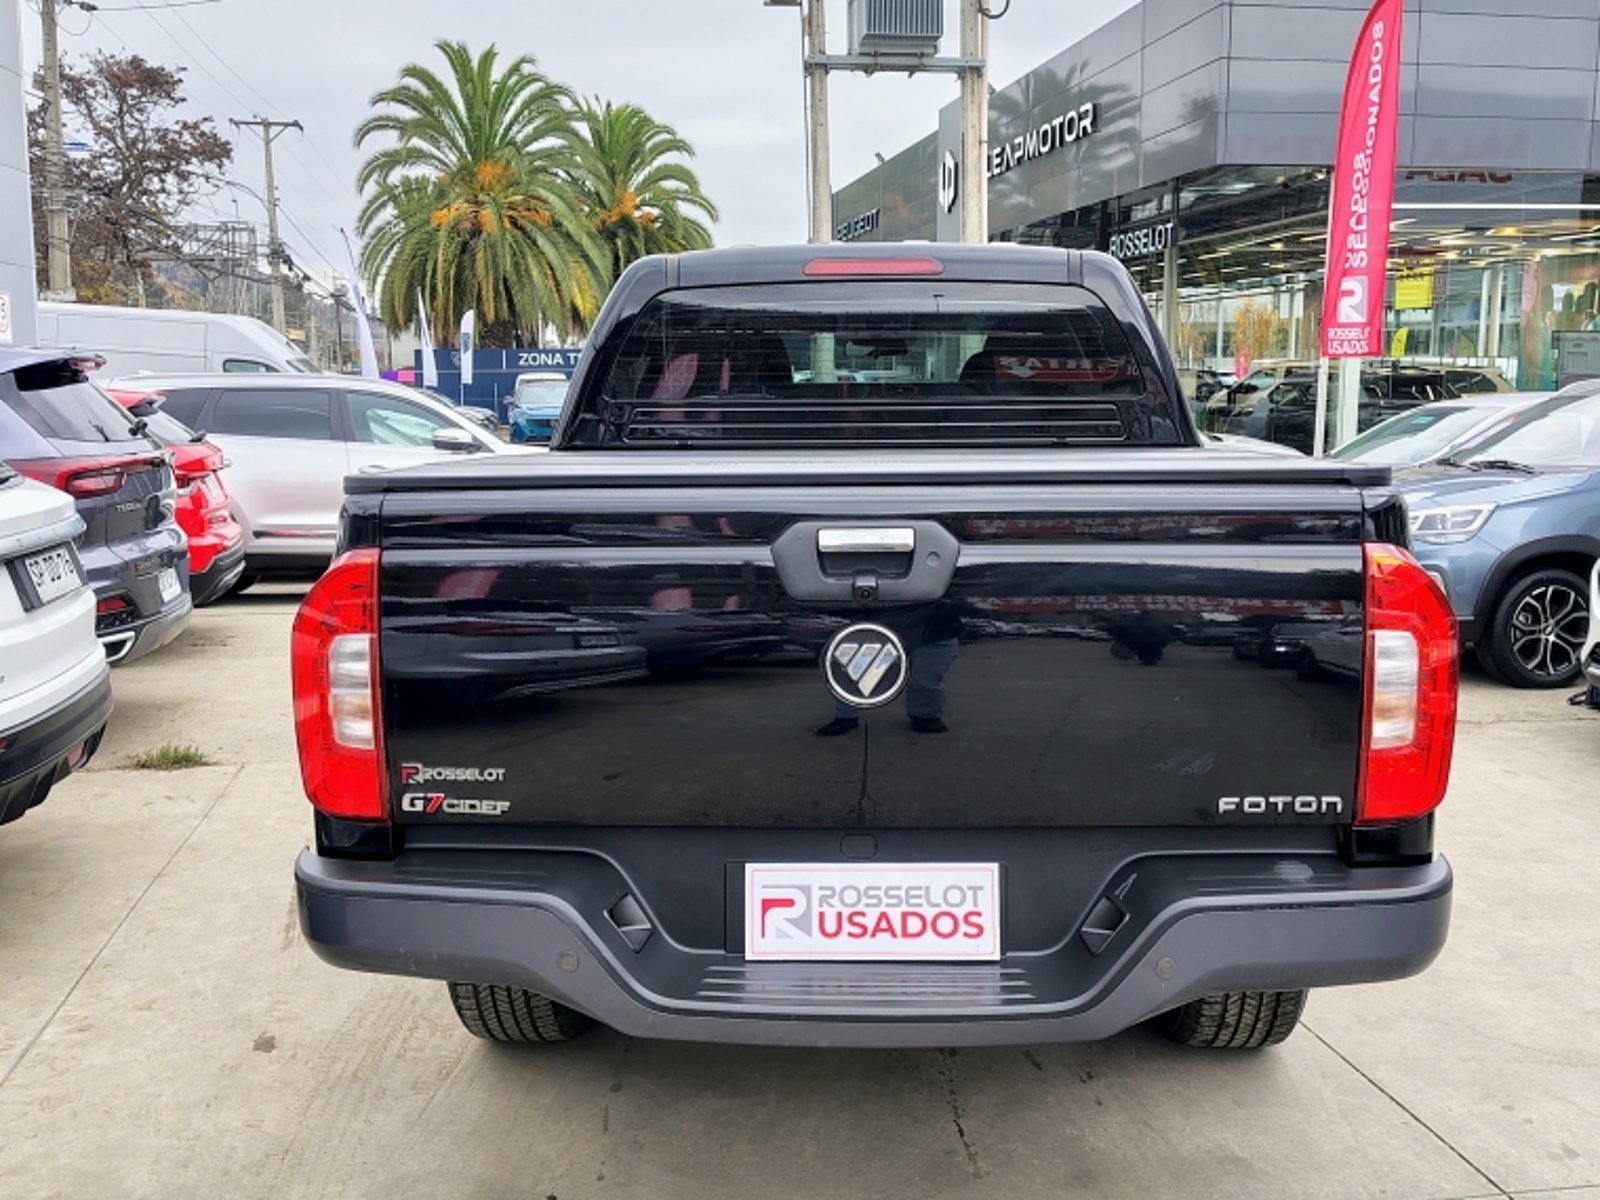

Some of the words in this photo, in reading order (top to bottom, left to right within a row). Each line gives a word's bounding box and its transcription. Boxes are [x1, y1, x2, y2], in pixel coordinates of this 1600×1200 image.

[836, 207, 880, 241] PEUGEOT
[1109, 222, 1174, 258] ROSSELOT
[1327, 327, 1370, 340] ROSSEL
[518, 352, 563, 366] ZONA
[422, 768, 505, 781] ROSSELOT
[1218, 795, 1343, 814] FOTON
[818, 885, 984, 908] ROSSELOT
[818, 910, 984, 939] USADOS
